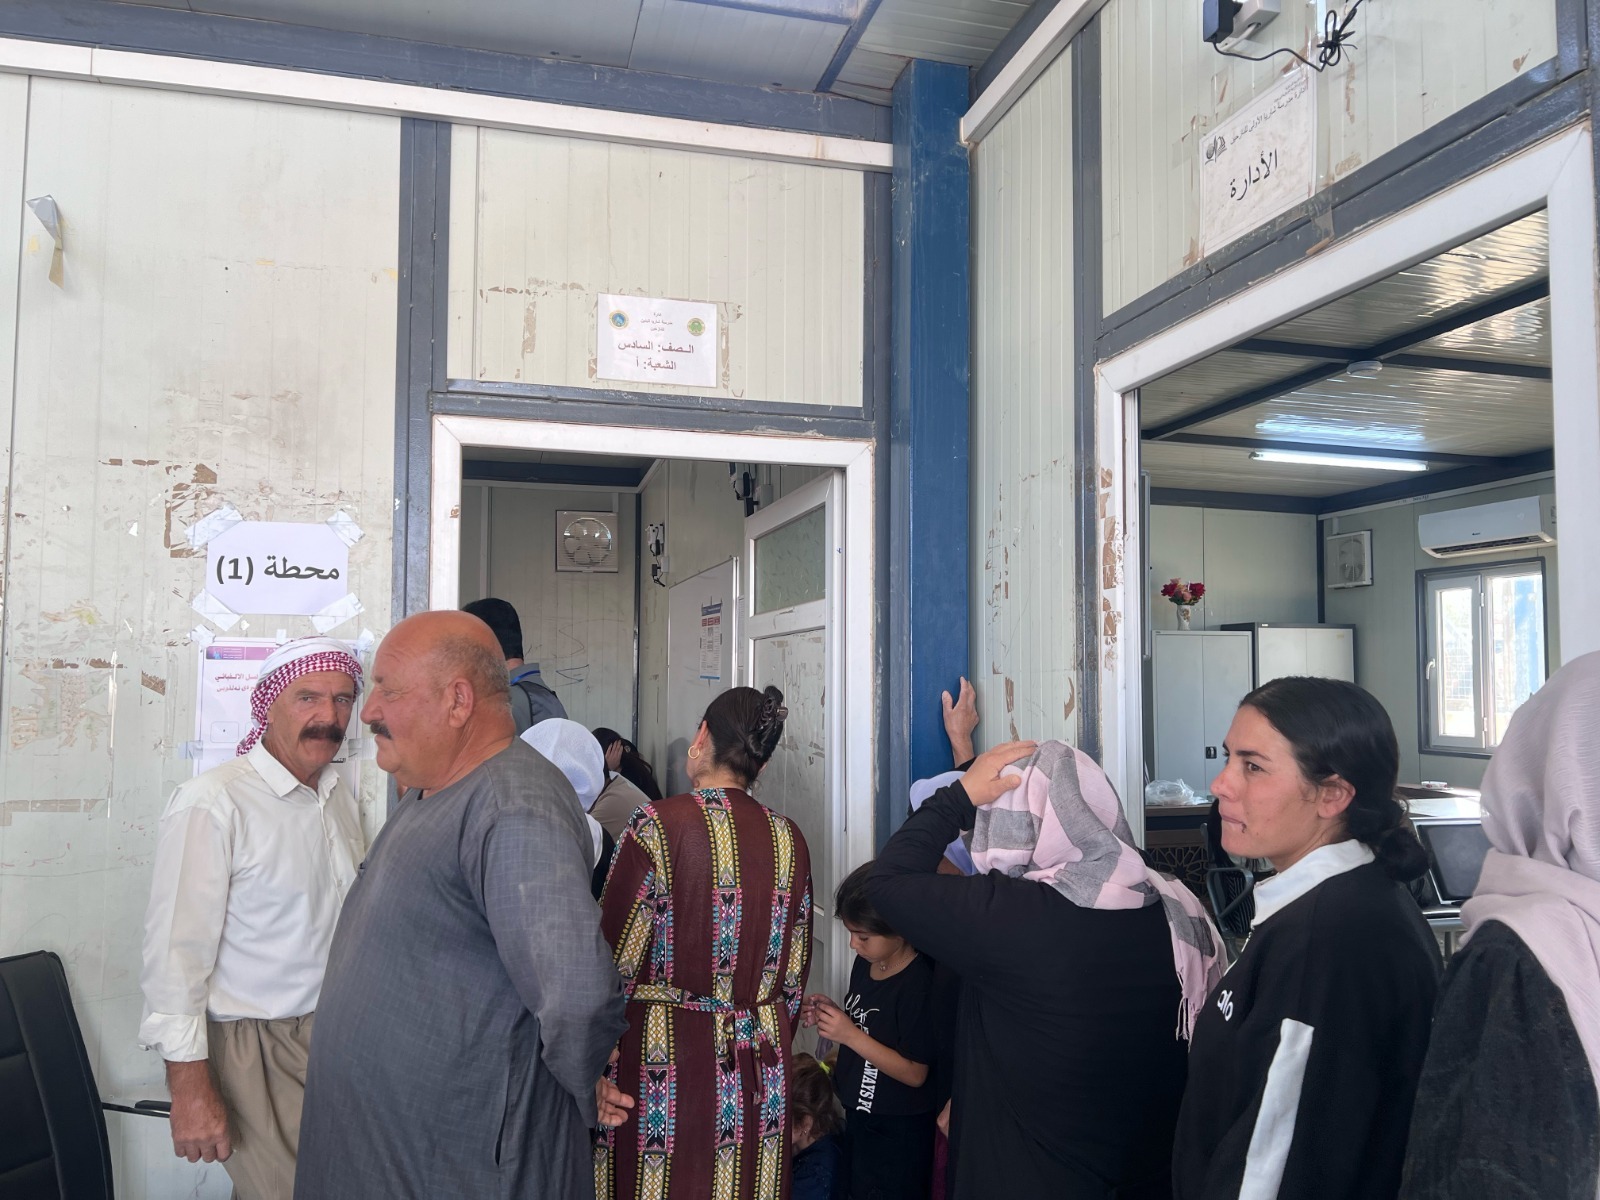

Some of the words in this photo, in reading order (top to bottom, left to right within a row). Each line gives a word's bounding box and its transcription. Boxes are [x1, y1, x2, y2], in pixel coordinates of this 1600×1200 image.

[1229, 148, 1278, 201] الأدارة
[618, 340, 653, 350] السادس
[643, 357, 677, 371] الشعبة:
[216, 555, 254, 585] (1)
[264, 555, 340, 580] محطة
[859, 1060, 878, 1099] LWAYS
